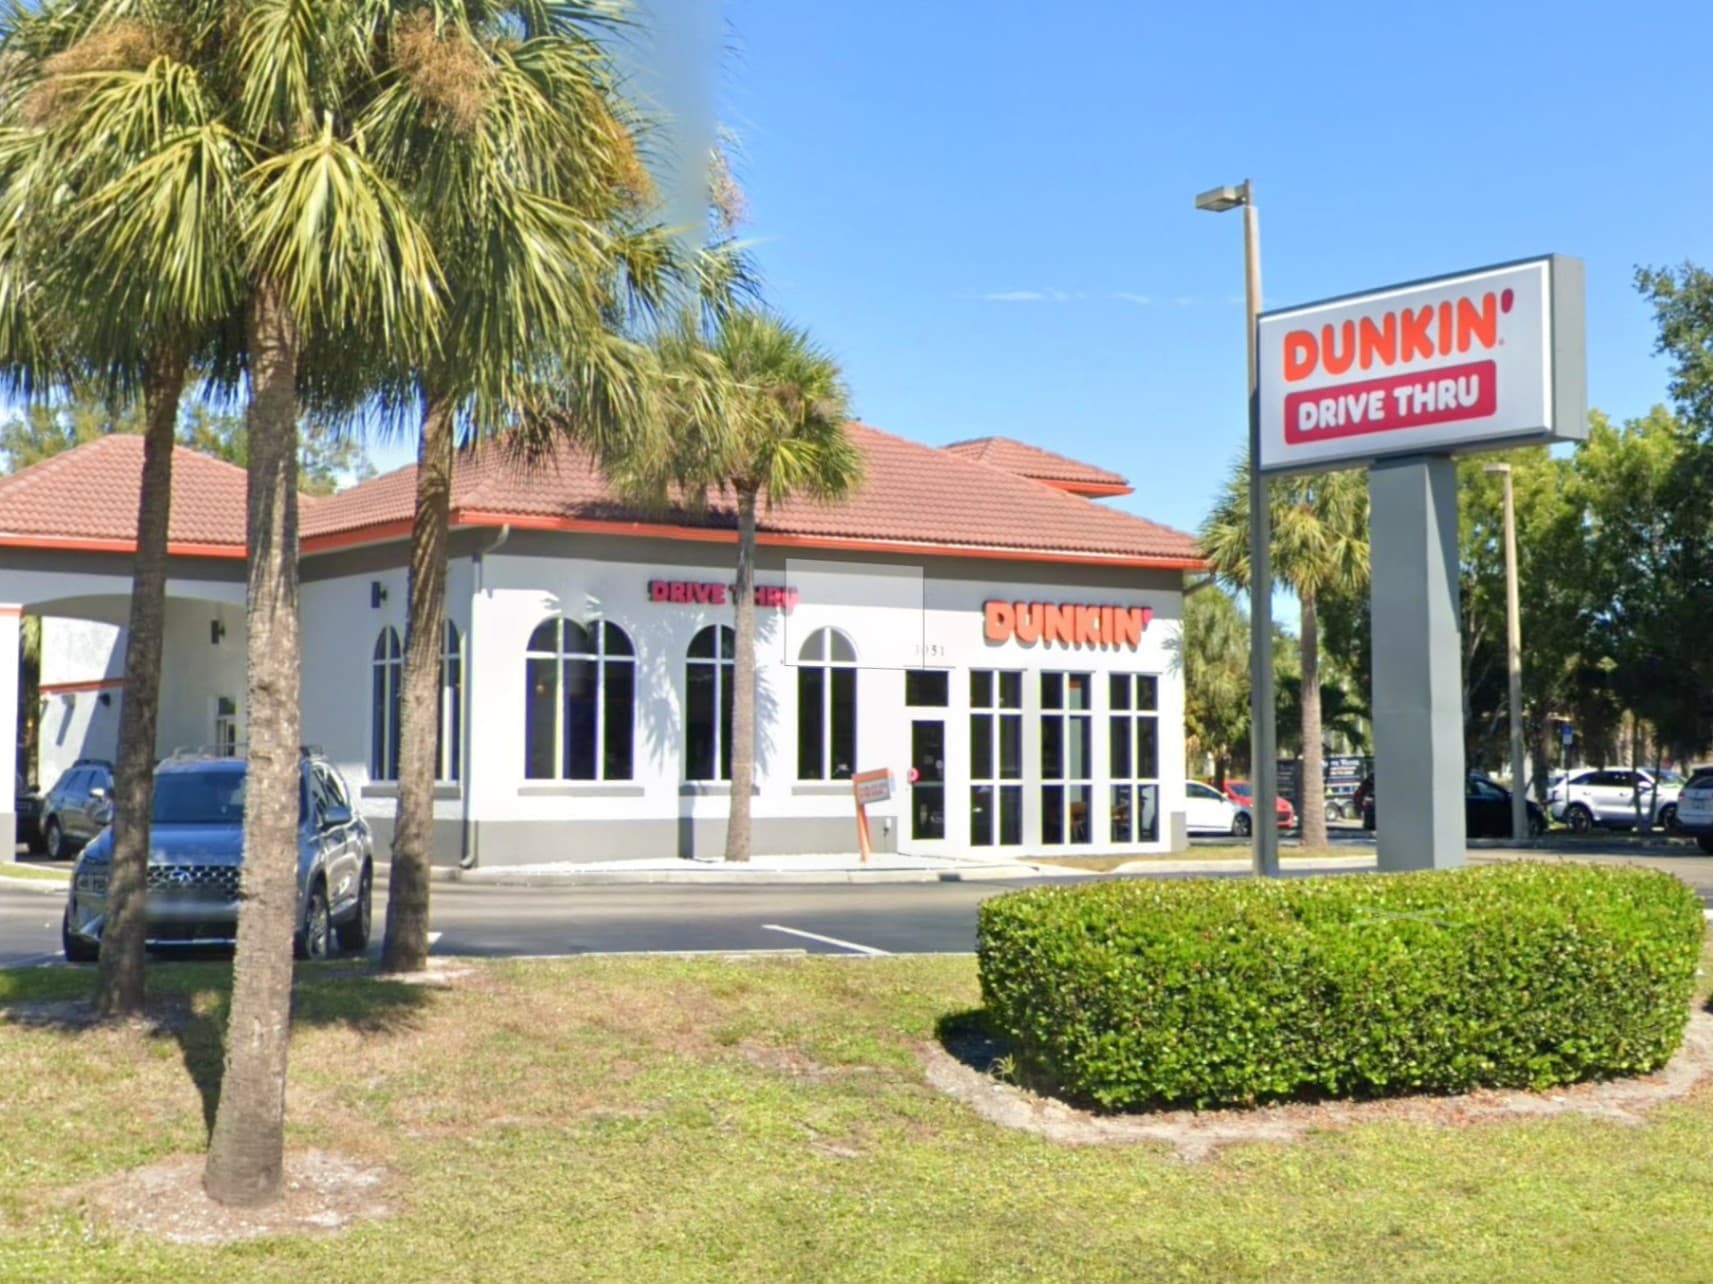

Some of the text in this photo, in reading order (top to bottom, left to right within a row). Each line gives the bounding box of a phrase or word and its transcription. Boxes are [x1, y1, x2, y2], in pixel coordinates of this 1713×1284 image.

[1283, 288, 1514, 382] DUNKIN'
[1297, 374, 1480, 432] DRIVE THRU
[649, 580, 726, 604] DRIVE
[983, 600, 1153, 647] DUNKIN'
